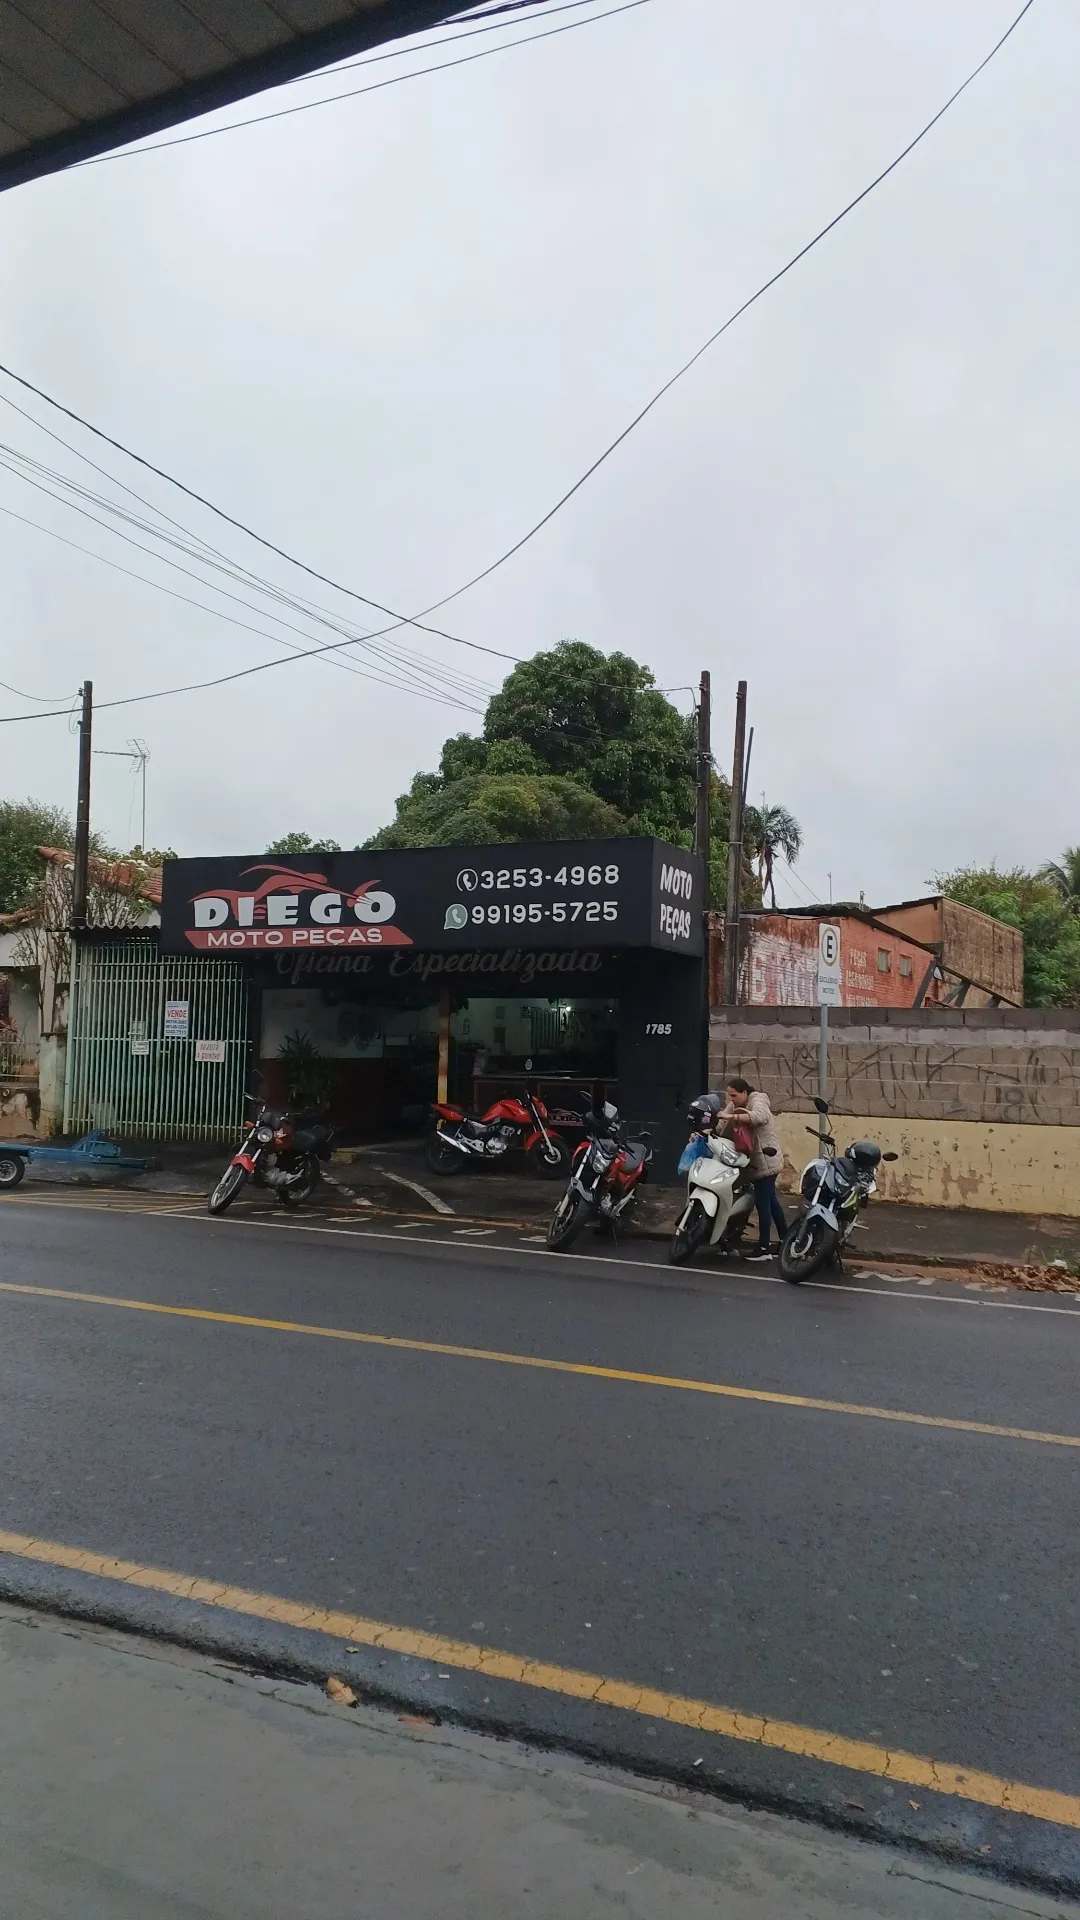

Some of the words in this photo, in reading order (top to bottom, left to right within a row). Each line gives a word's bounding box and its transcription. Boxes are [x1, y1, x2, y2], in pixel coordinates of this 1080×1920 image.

[480, 864, 620, 890] 3253-4968
[659, 863, 693, 900] MOTO
[193, 891, 396, 928] DIEGO
[470, 901, 619, 925] 99195-5725
[659, 903, 692, 941] PEÇAS
[207, 930, 284, 947] MOTO
[292, 928, 383, 946] PEÇAS
[826, 936, 833, 958] E
[274, 951, 374, 985] Oficina
[388, 948, 604, 984] Especializada
[645, 1023, 673, 1035] 1785
